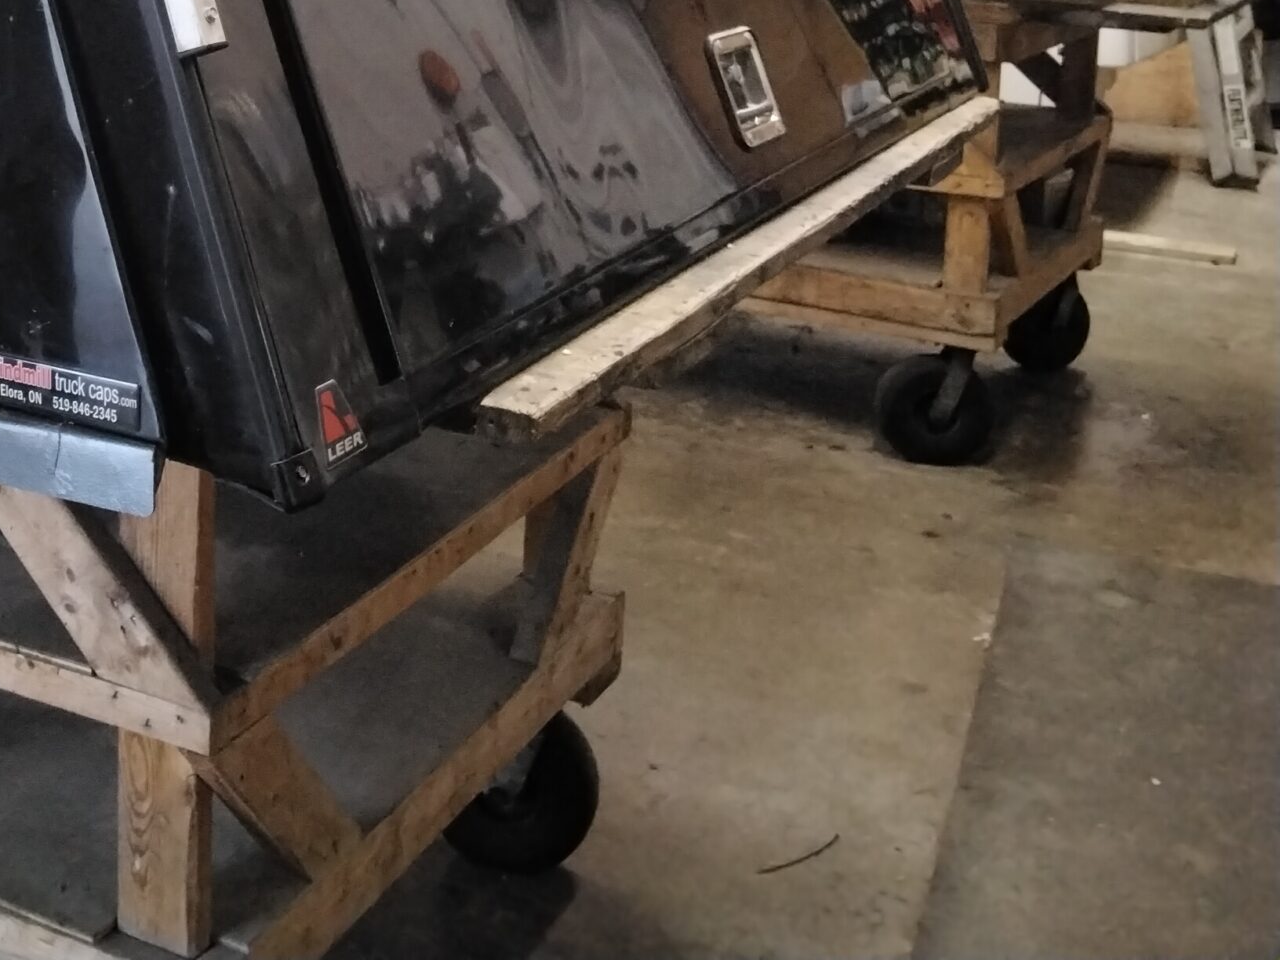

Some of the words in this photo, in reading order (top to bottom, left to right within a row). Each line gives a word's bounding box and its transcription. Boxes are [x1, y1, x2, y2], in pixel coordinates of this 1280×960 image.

[55, 372, 86, 397] truck
[0, 383, 26, 404] Elora,
[28, 390, 43, 405] ON
[52, 396, 118, 424] 519-846-2345
[327, 431, 364, 462] LEER
